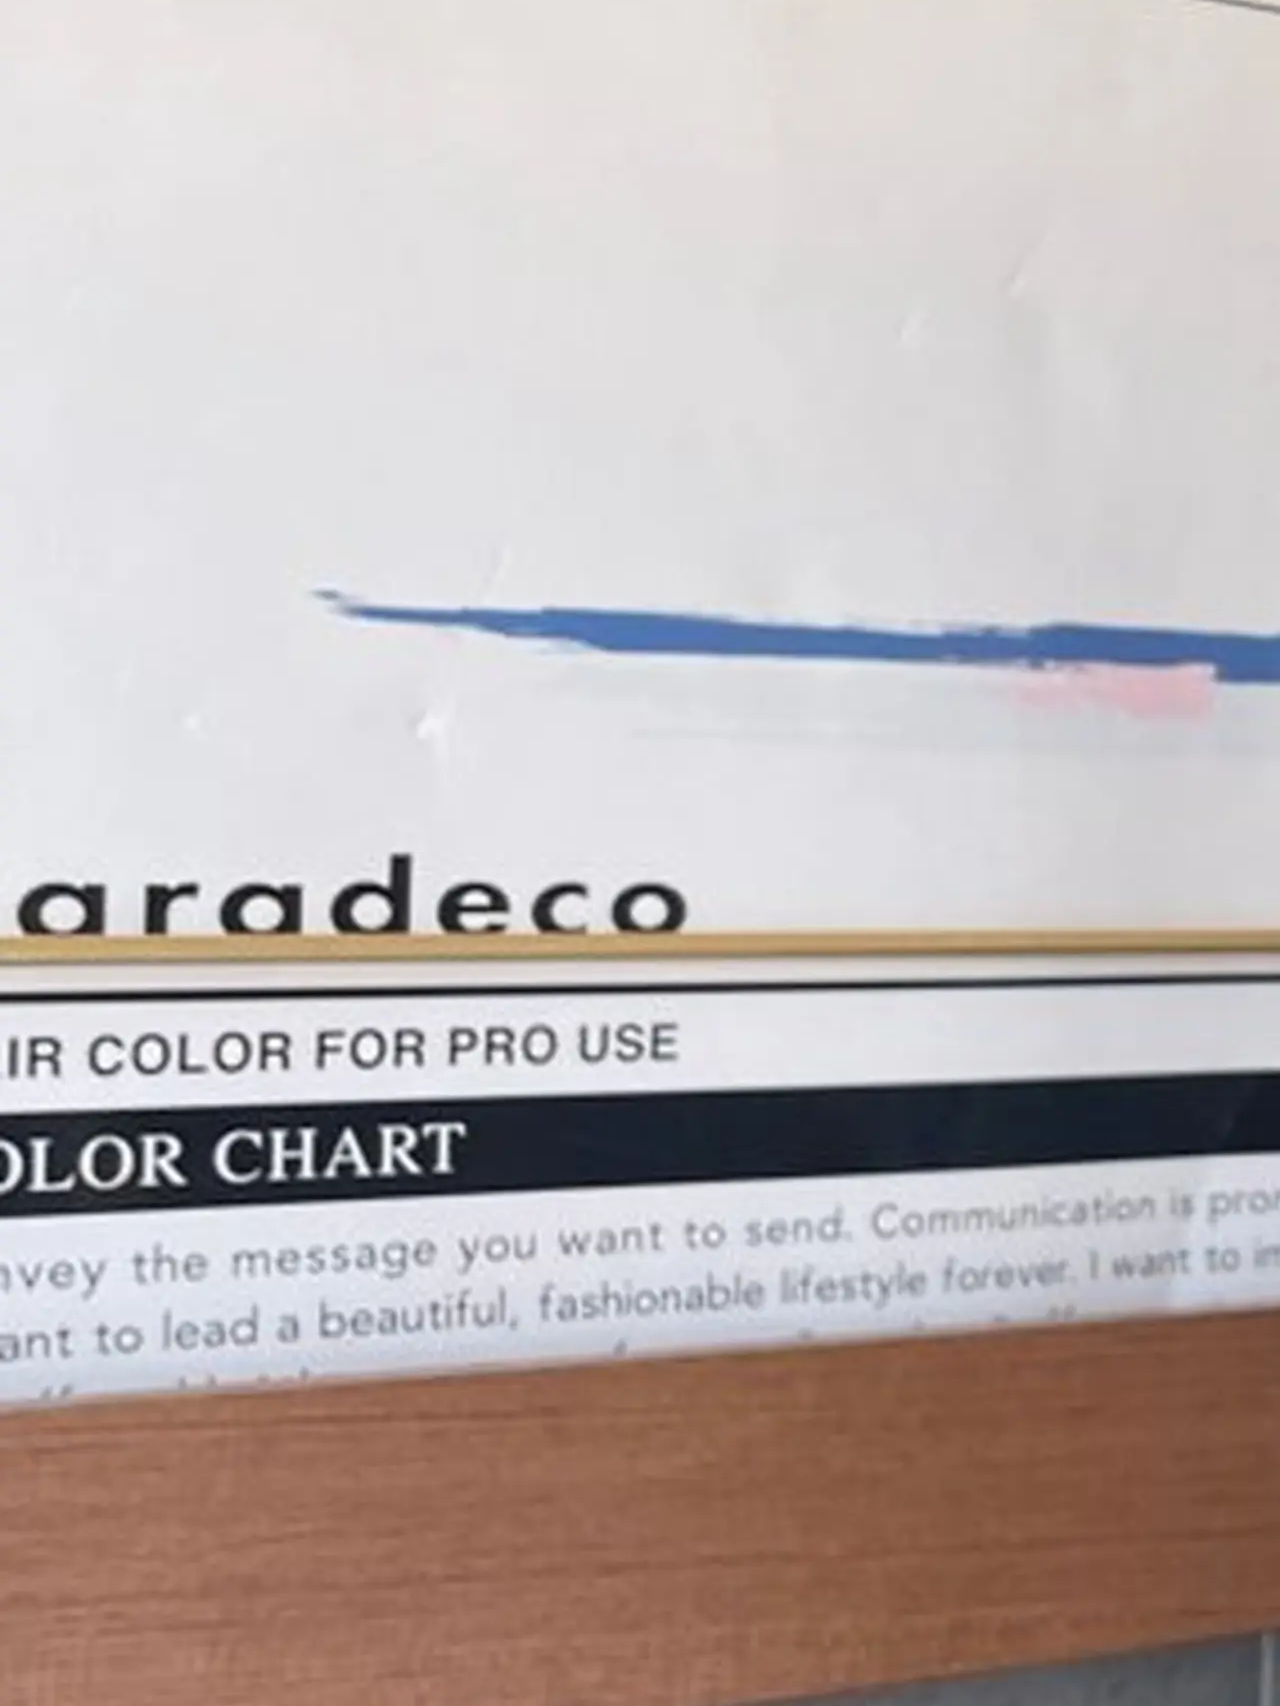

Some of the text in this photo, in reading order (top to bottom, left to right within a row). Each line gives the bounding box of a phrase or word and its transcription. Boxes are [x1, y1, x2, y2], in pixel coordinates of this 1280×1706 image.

[0, 1023, 679, 1078] IR COLOR FOR PRO USE
[212, 1122, 467, 1182] CHART
[131, 1242, 208, 1287] the
[232, 1235, 437, 1279] message
[457, 1231, 537, 1275] you
[558, 1220, 662, 1257] want
[684, 1219, 727, 1250] to
[870, 1187, 1157, 1241] Communication
[1168, 1186, 1196, 1219] is
[94, 1322, 145, 1356] to
[161, 1303, 260, 1351] lead
[276, 1313, 301, 1344] a
[317, 1287, 518, 1340] beautiful,
[538, 1271, 766, 1324] fashionable
[780, 1257, 928, 1311] lifestyle
[1088, 1248, 1099, 1282] I
[1111, 1246, 1192, 1281] want
[1205, 1242, 1242, 1274] to
